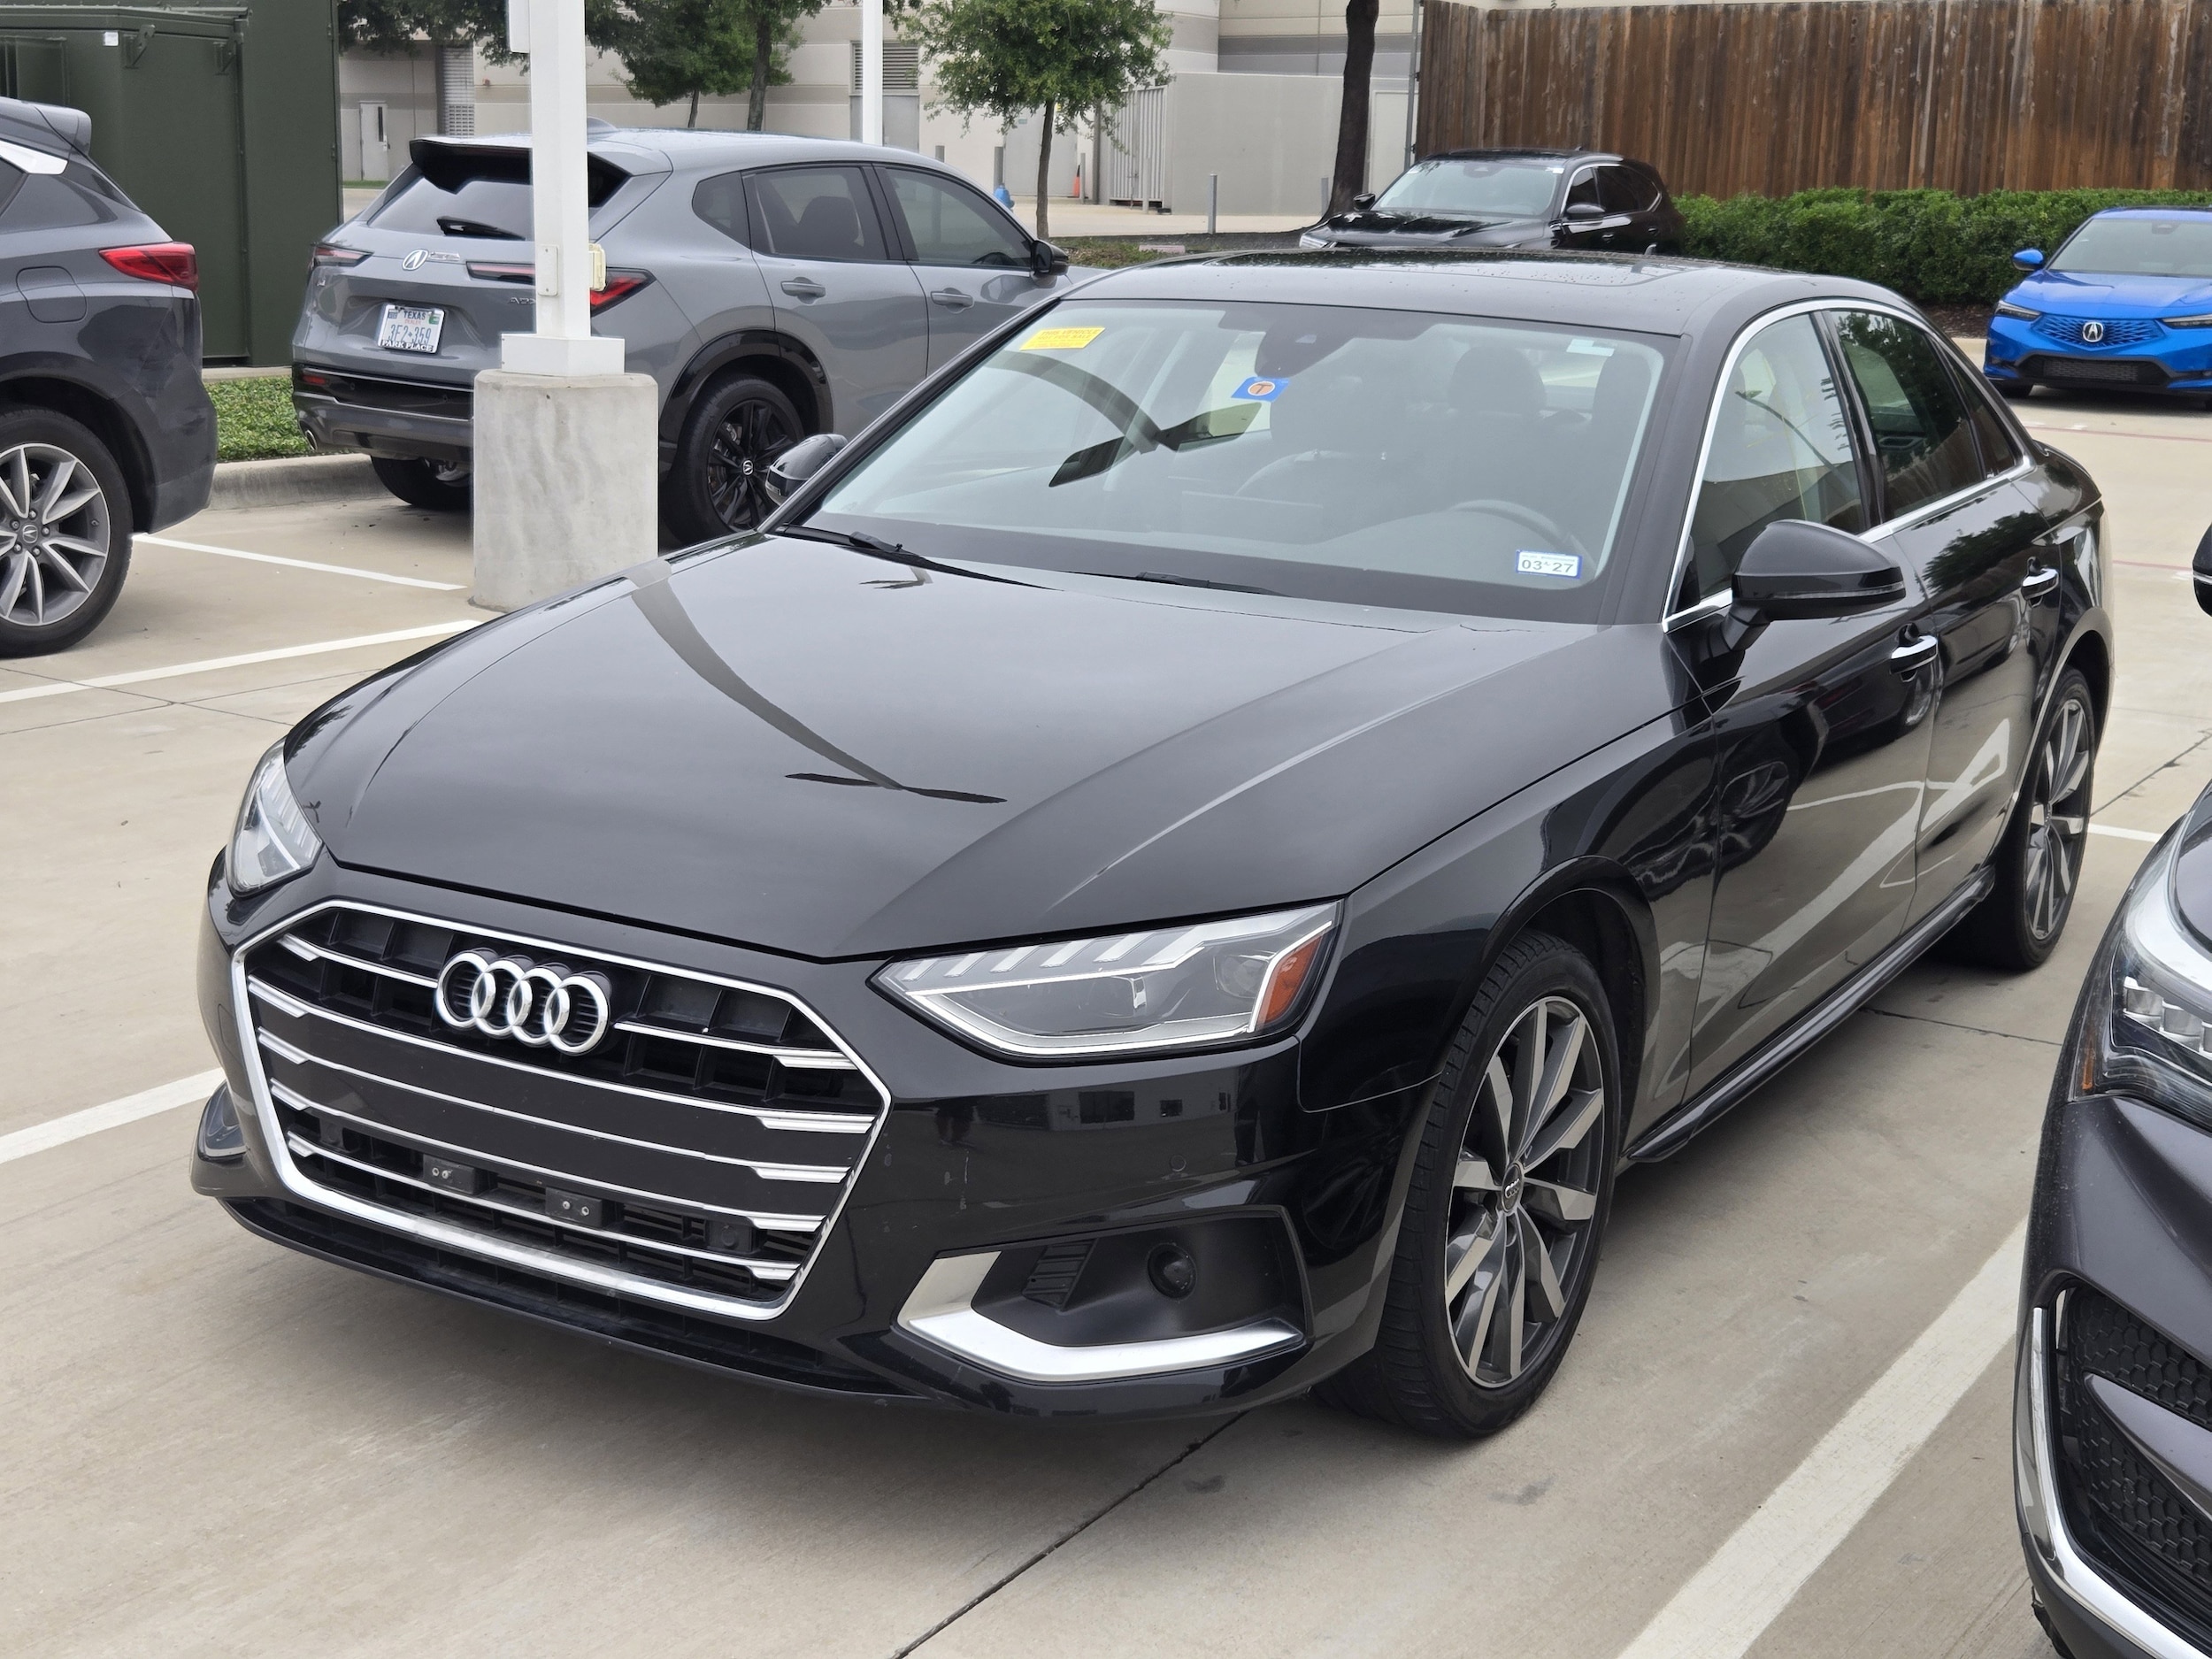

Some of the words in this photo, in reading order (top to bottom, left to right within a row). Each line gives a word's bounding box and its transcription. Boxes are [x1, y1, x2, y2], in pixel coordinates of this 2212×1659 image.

[403, 311, 426, 320] TEXAS
[405, 342, 433, 351] PLACE
[1522, 559, 1542, 571] 03
[1552, 562, 1574, 573] 27
